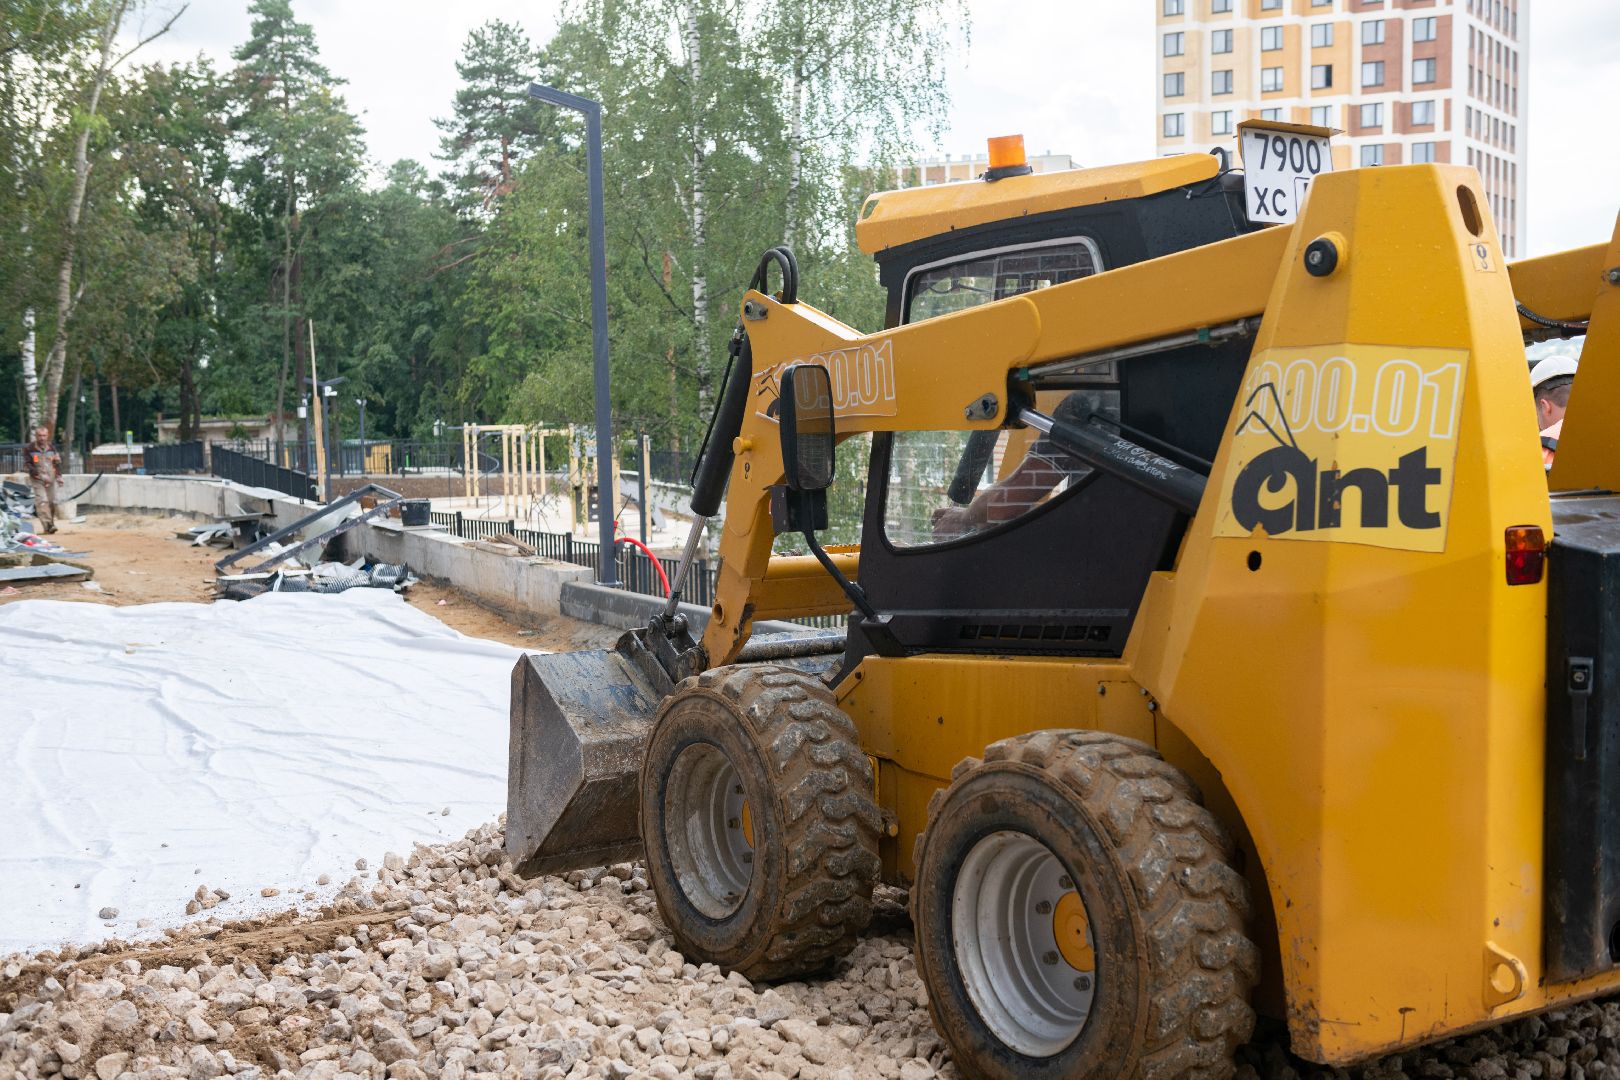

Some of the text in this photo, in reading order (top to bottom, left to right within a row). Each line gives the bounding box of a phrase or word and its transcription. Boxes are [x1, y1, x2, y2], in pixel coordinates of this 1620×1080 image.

[1254, 132, 1321, 175] 7900
[1254, 186, 1288, 217] XC
[1231, 445, 1442, 536] ant
